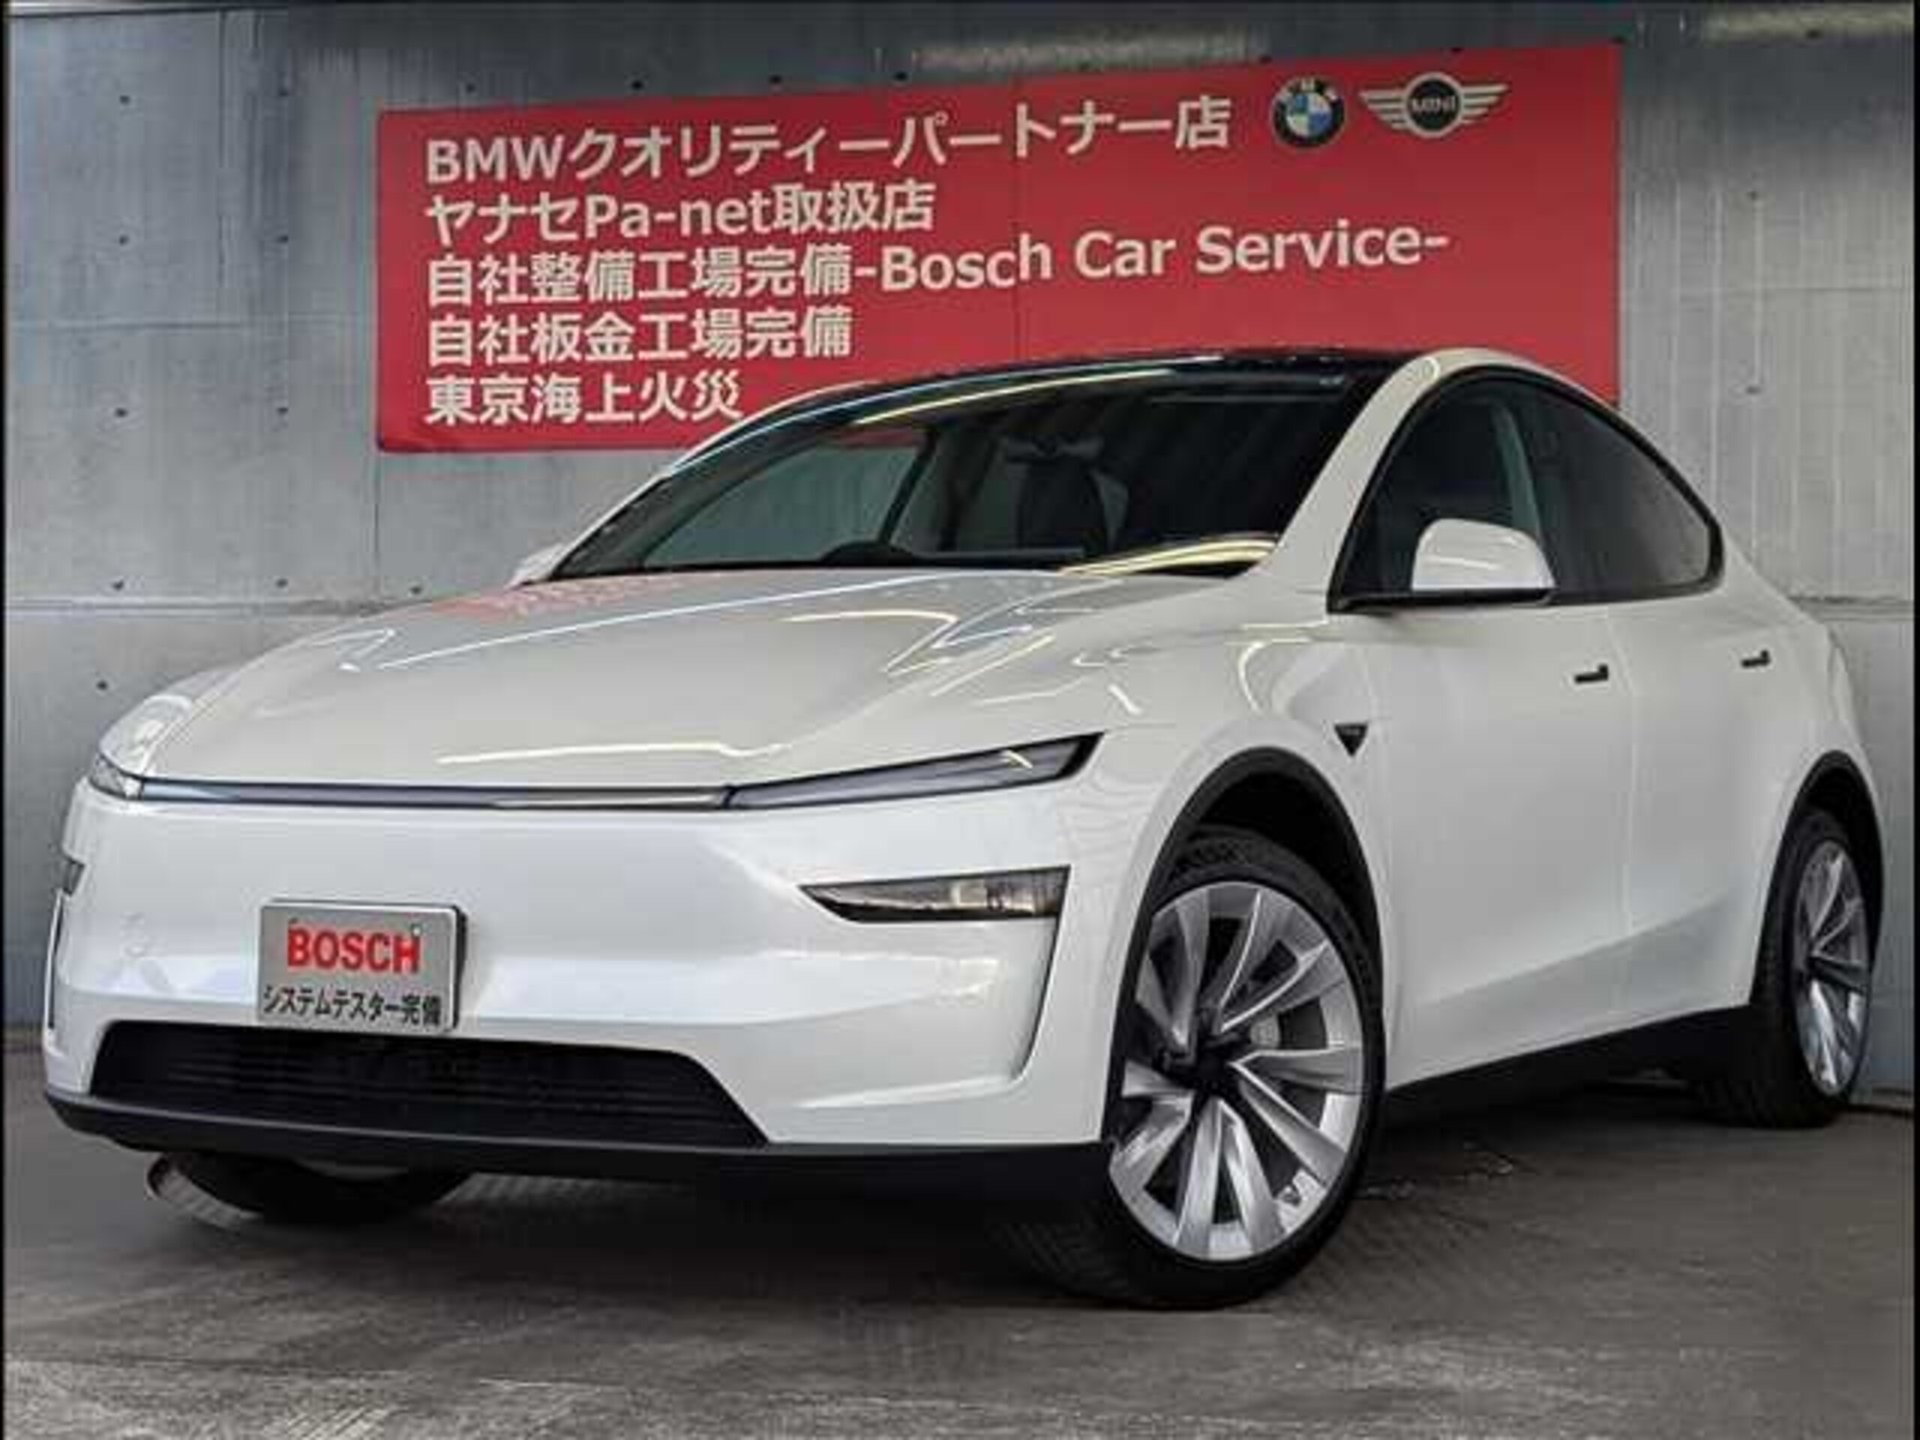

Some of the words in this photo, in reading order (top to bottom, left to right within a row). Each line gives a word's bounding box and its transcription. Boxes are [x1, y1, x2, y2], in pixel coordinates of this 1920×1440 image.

[425, 96, 1231, 184] BMWクオリティーパートナー店
[425, 179, 936, 246] ヤナセPa-net取扱店
[1074, 231, 1177, 278] Car
[1195, 216, 1449, 274] Service-
[427, 304, 854, 366] 自社板金工場完備
[424, 368, 744, 426] 東京海上火災
[287, 926, 421, 973] BOSCH
[263, 986, 441, 1026] システムテスター完備
